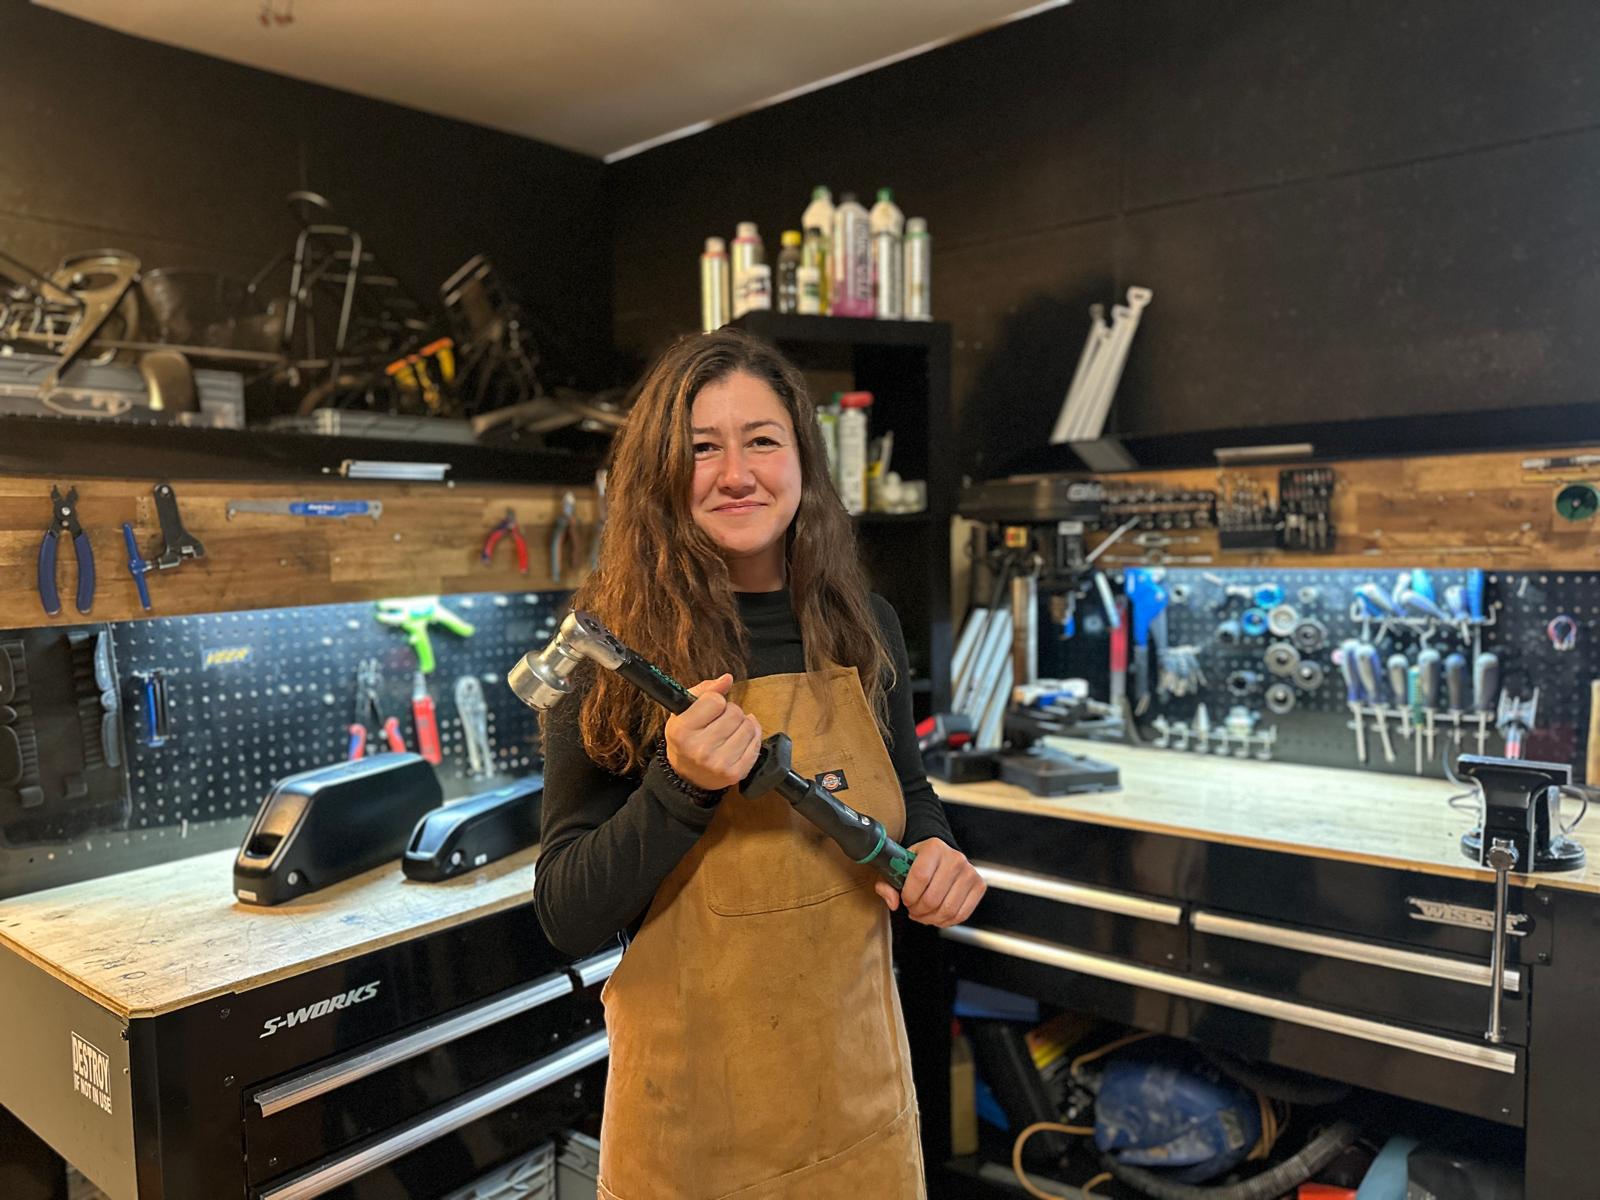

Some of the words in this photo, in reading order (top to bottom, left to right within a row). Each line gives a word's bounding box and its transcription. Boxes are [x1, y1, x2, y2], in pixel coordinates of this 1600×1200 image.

[259, 980, 381, 1038] S-WORKS
[72, 1036, 109, 1093] DESTROY
[80, 1077, 92, 1099] NOT
[92, 1086, 99, 1105] IN
[99, 1090, 112, 1115] USE
